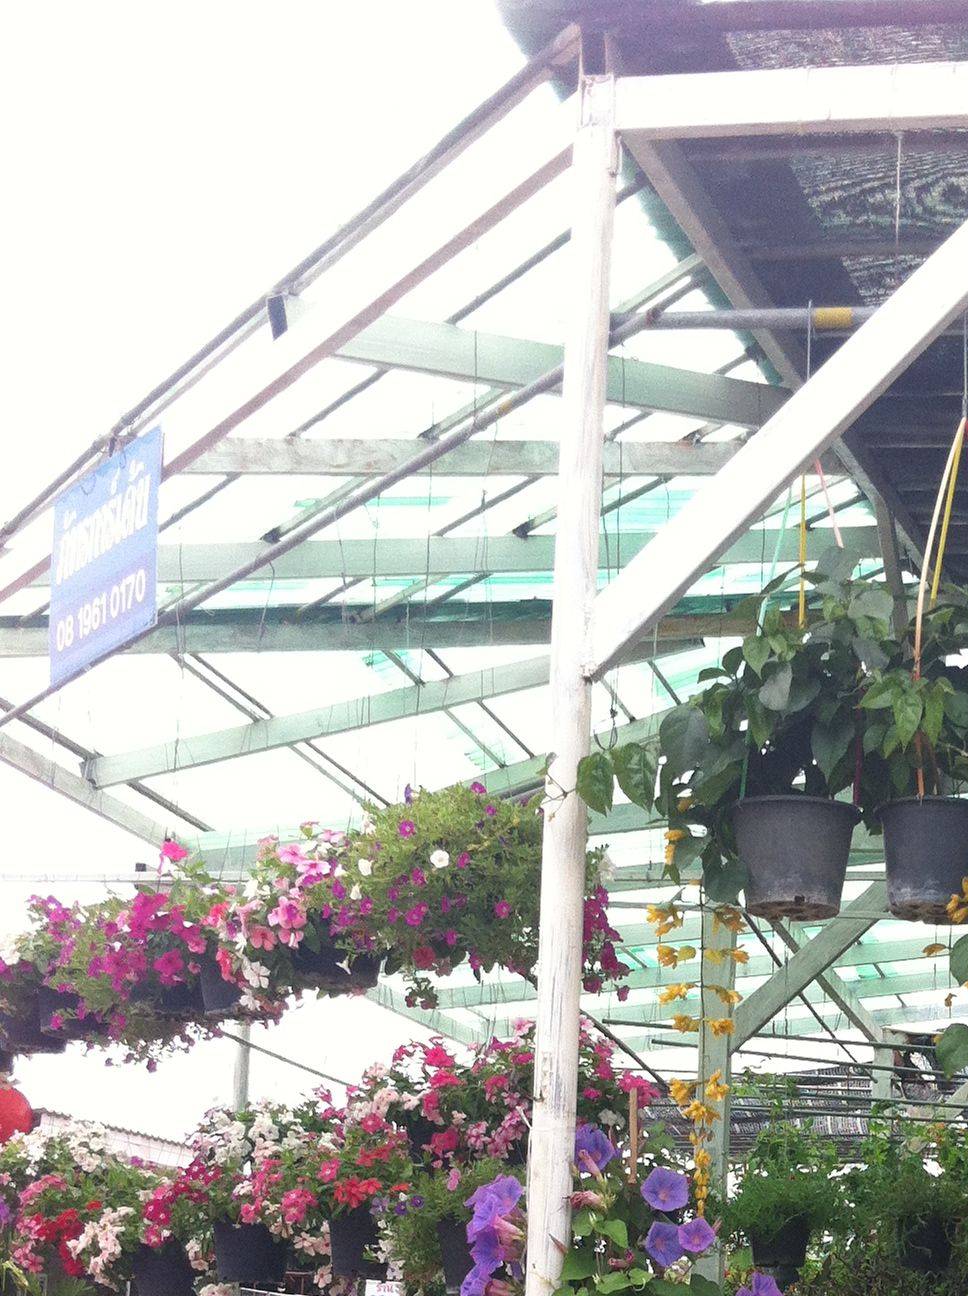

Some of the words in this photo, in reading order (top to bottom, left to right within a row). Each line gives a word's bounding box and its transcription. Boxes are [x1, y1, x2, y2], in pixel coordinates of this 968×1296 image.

[56, 614, 74, 652] 08
[78, 593, 107, 638] 1961
[109, 569, 146, 619] 0170
